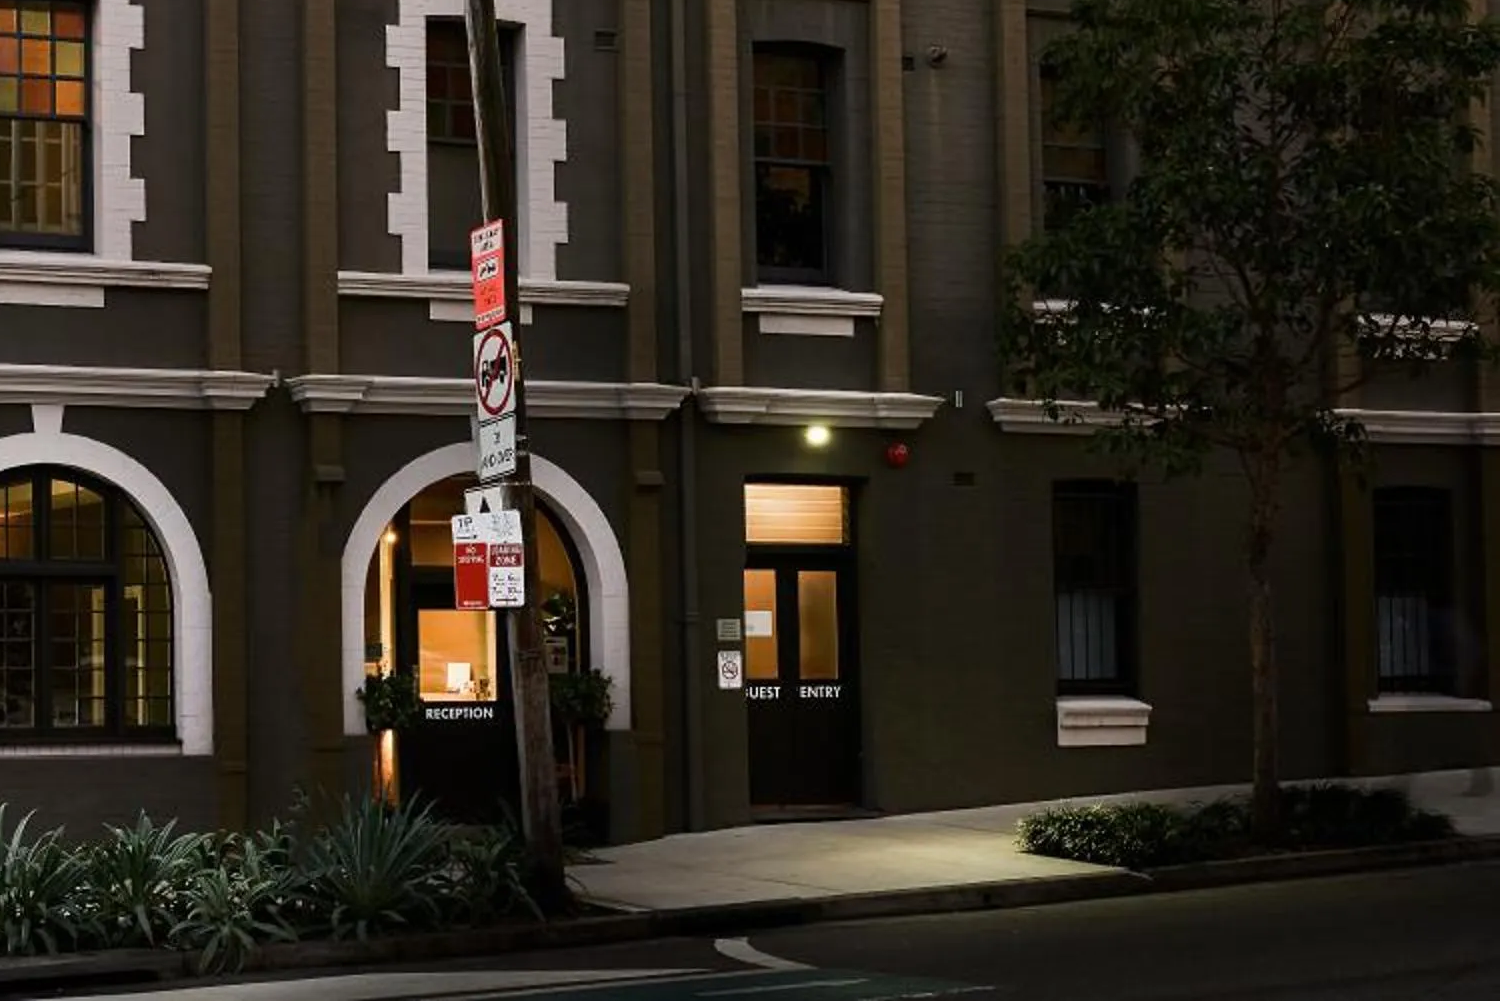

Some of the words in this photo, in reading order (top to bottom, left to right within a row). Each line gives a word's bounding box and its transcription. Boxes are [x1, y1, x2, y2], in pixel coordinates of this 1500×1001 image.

[745, 686, 781, 699] UEST
[799, 686, 841, 698] ENTRY
[425, 707, 493, 719] RECEPTION
